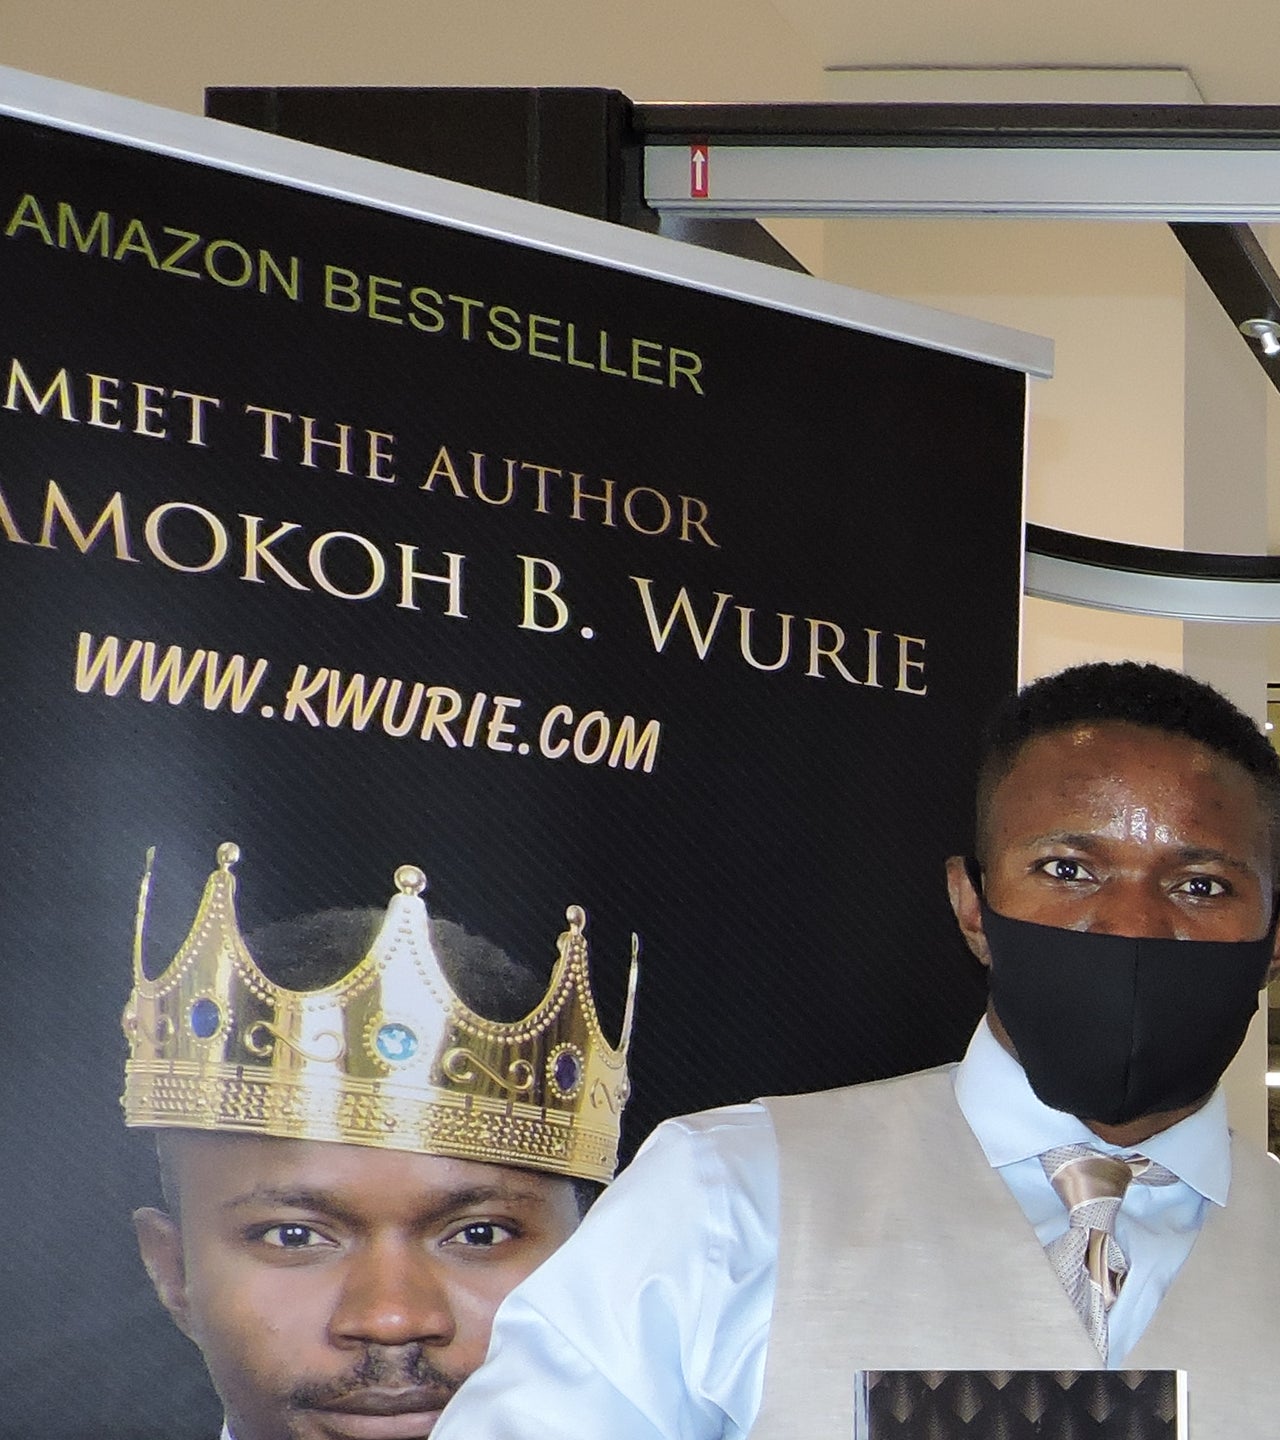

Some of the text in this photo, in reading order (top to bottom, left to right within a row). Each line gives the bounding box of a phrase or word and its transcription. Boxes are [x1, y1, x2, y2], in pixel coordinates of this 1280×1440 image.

[4, 193, 705, 394] AMAZON BESTSELLER
[4, 359, 720, 548] MEET THE AUTHOR
[518, 555, 595, 641] B.
[75, 632, 661, 774] WWW.KWURIE.COM
